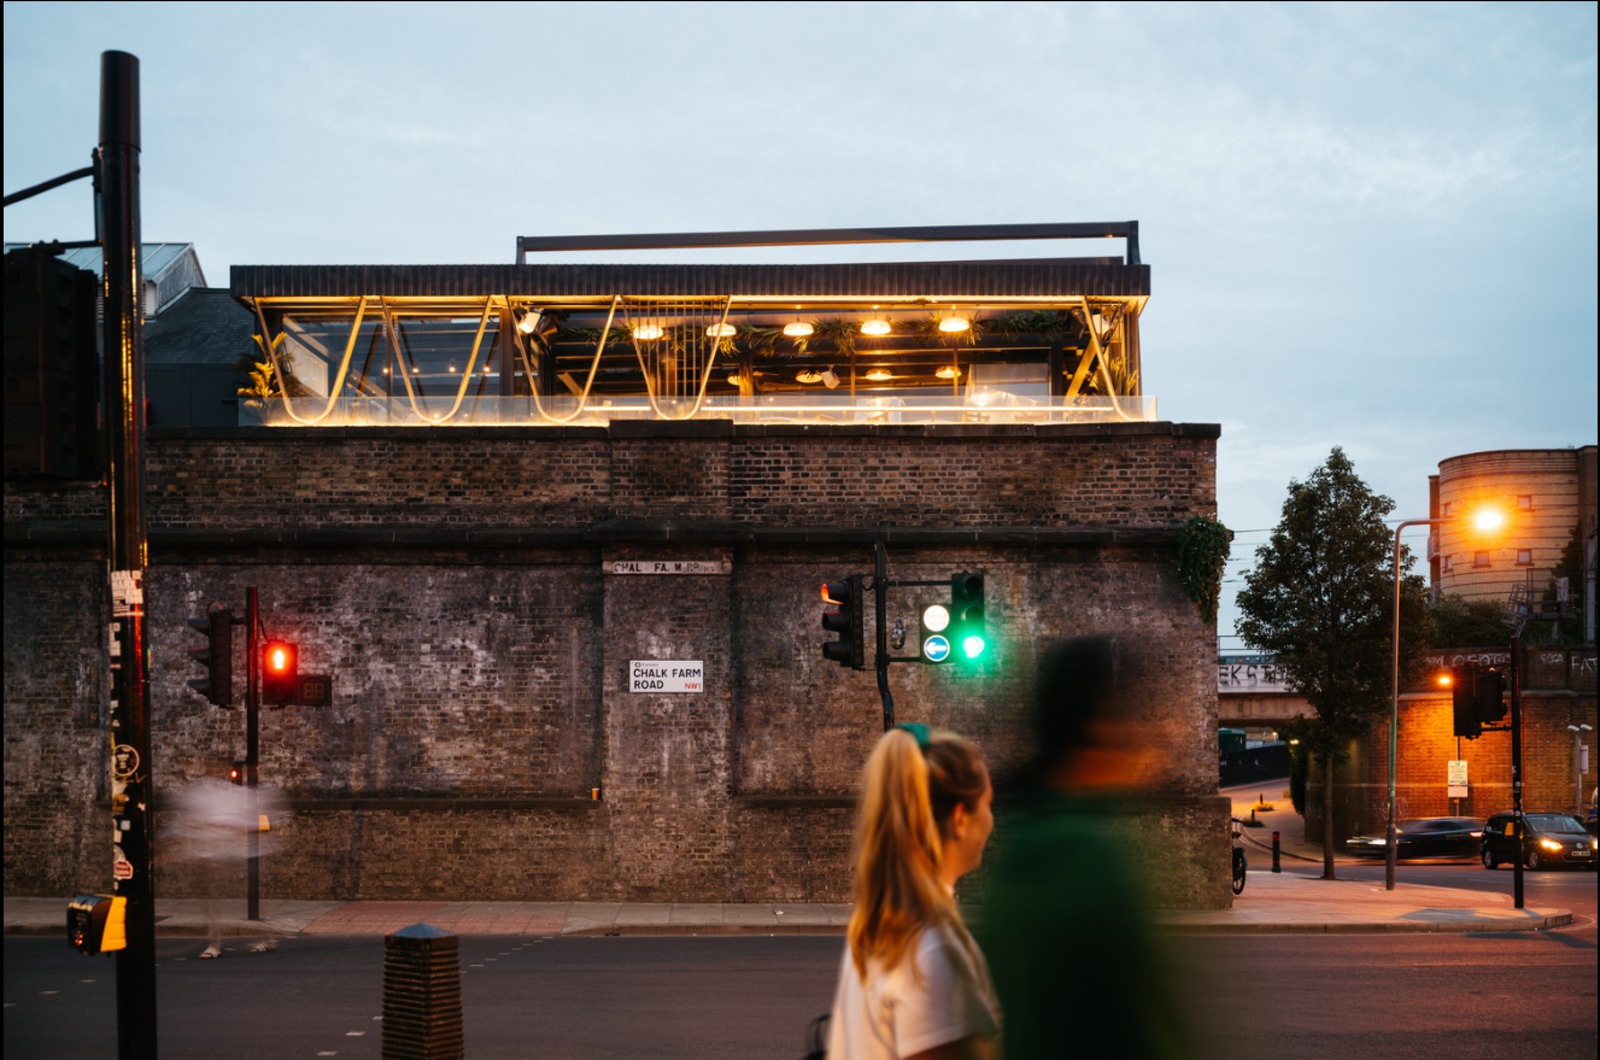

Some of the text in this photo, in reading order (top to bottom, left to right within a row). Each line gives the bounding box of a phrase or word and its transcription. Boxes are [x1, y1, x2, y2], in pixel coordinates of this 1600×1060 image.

[654, 562, 682, 573] FAM
[633, 668, 701, 678] CHALK FARM
[633, 680, 701, 690] ROAD NW1
